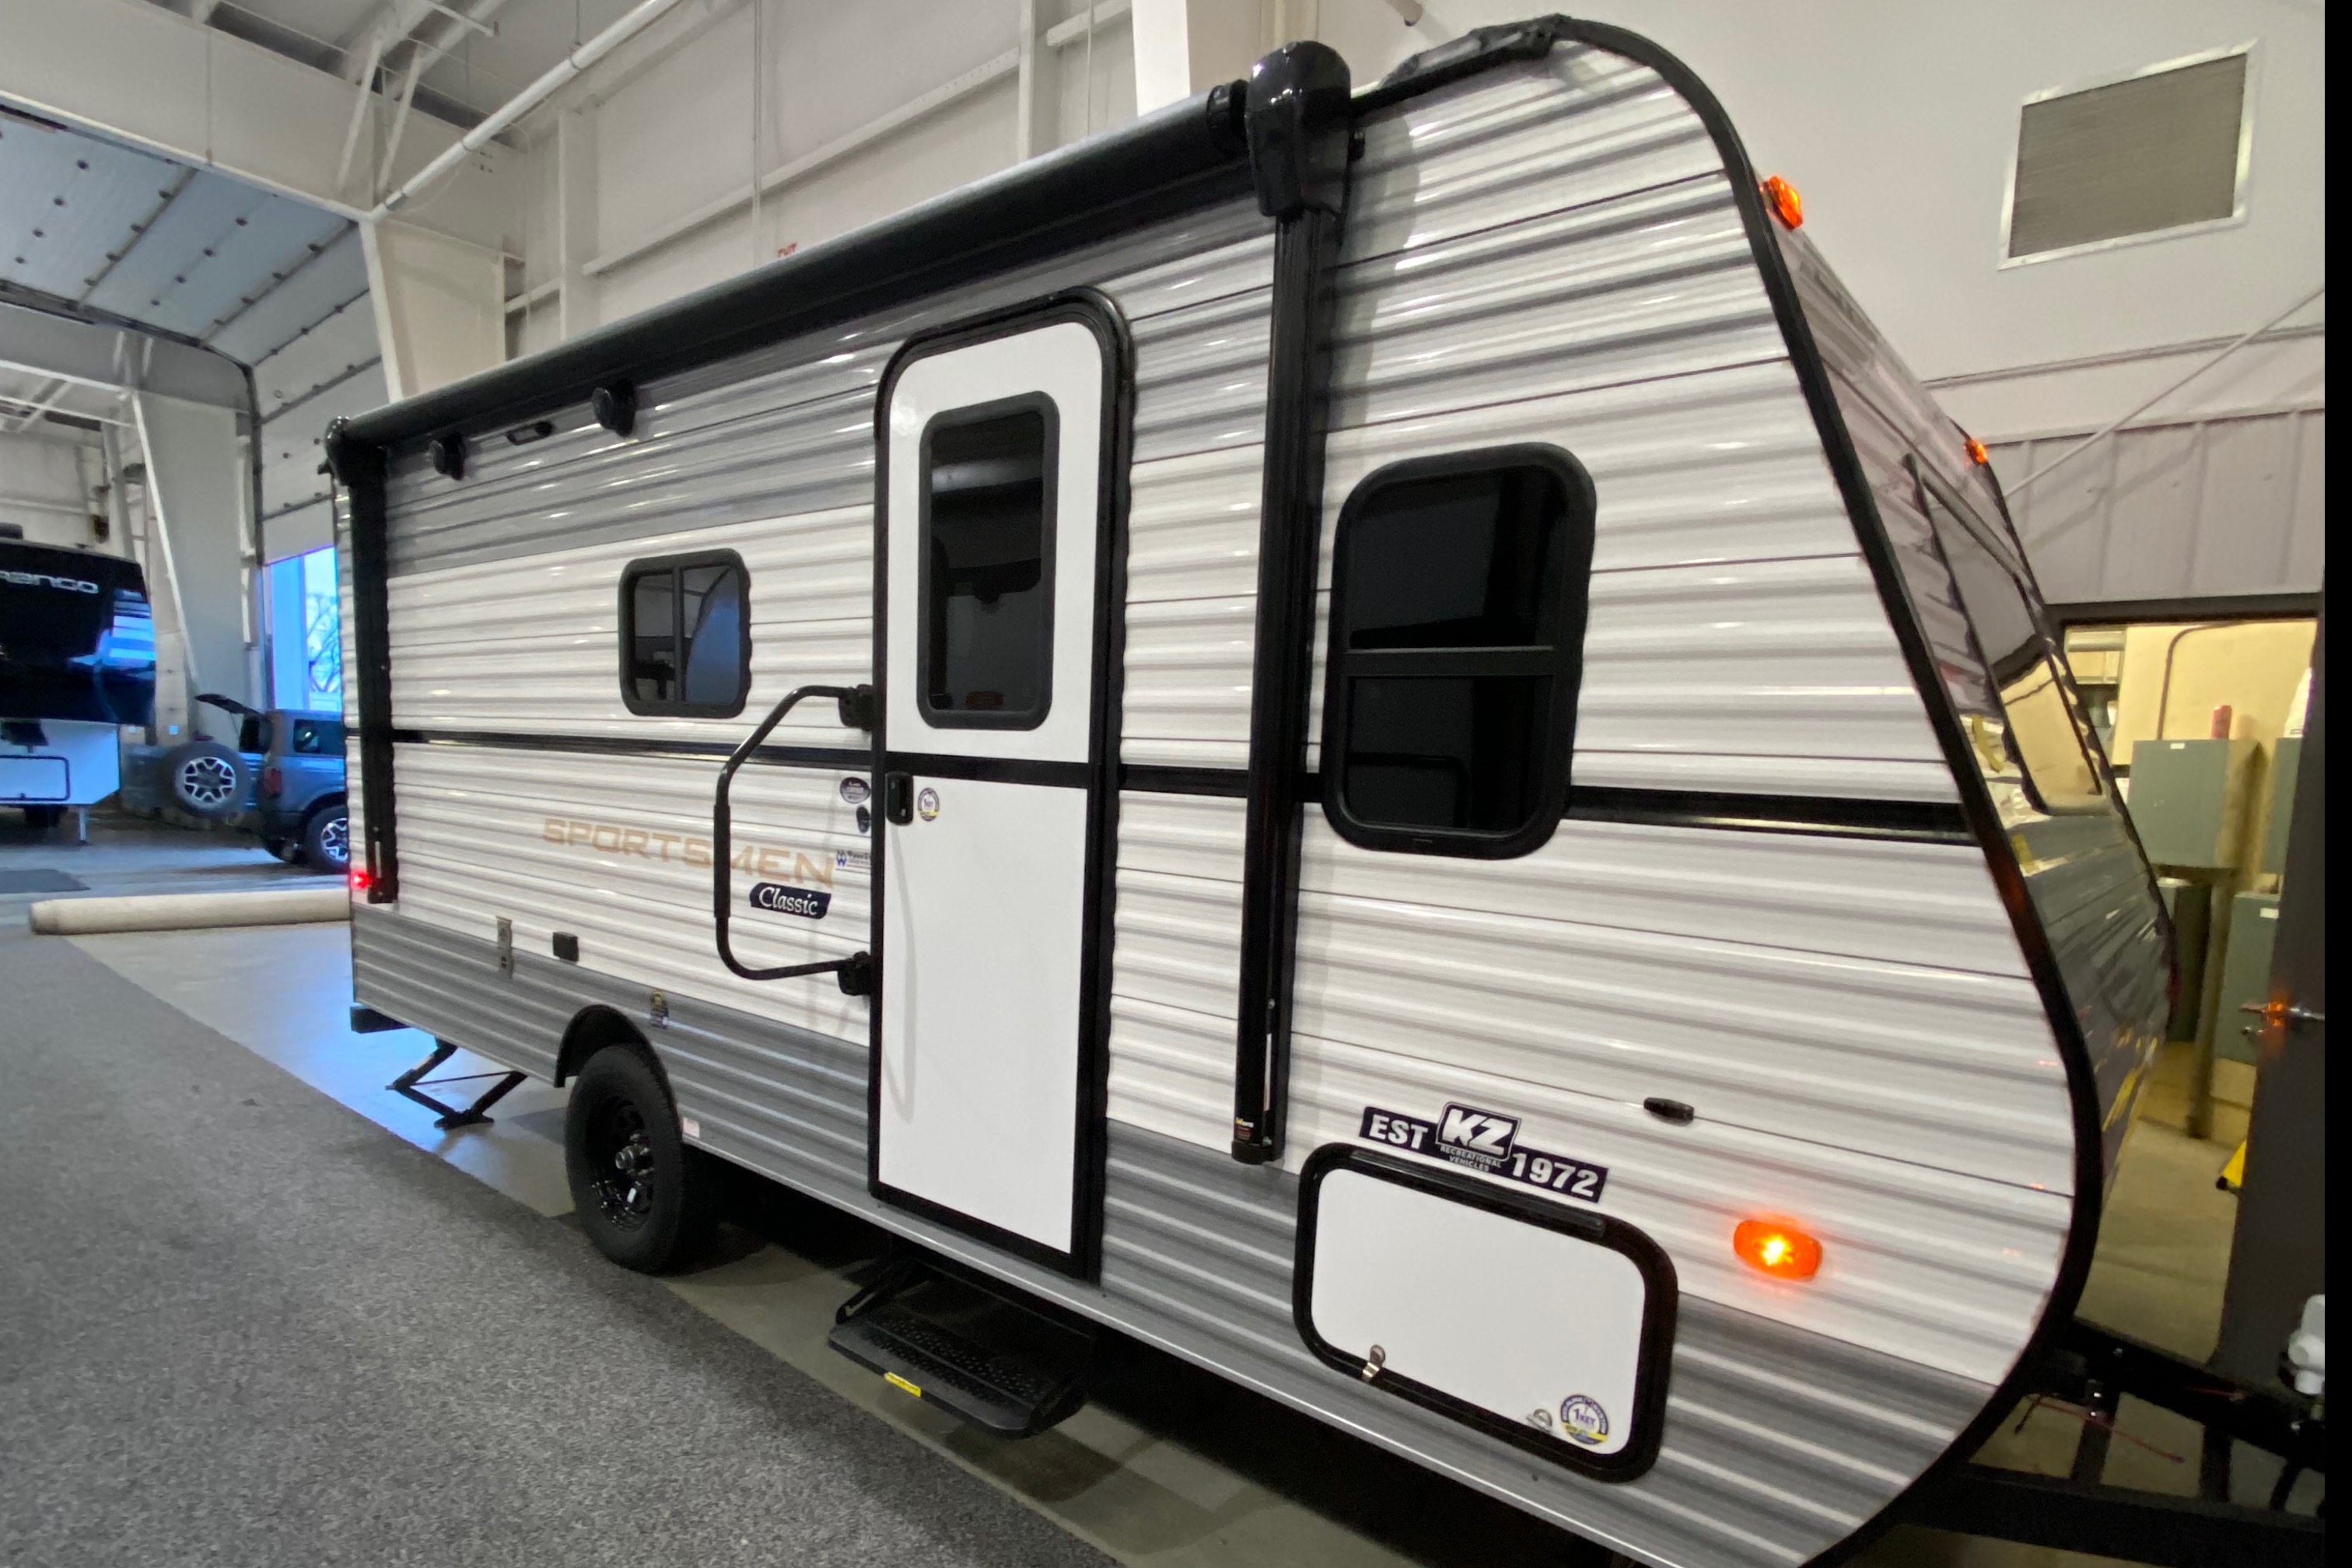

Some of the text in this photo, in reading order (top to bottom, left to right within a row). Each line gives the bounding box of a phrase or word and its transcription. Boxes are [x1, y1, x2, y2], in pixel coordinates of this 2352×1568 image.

[758, 886, 818, 915] Classic
[1369, 1114, 1429, 1150] EST
[1442, 1108, 1514, 1156] KZ
[1440, 1146, 1502, 1168] RECREATIONAL
[1449, 1156, 1490, 1173] VEHICLES
[1511, 1153, 1598, 1197] 1972
